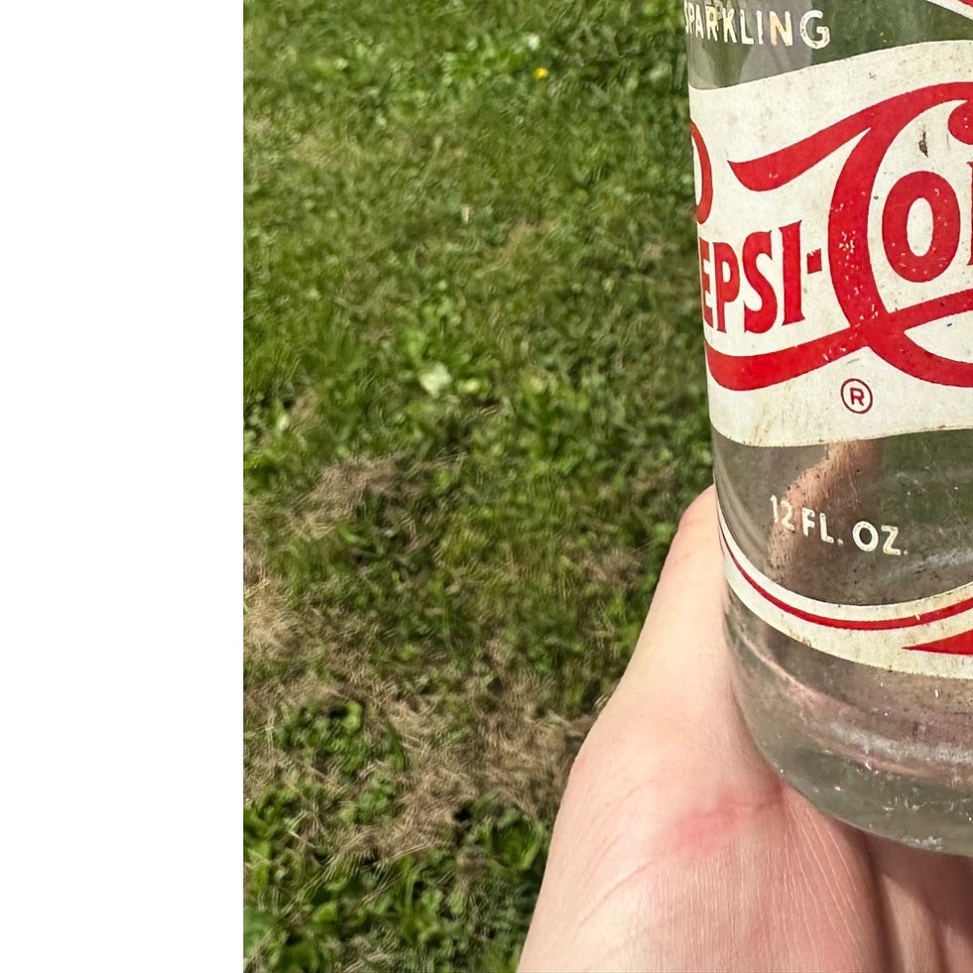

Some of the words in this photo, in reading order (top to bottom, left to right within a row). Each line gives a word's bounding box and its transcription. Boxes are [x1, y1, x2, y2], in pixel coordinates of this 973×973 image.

[769, 494, 796, 531] 12
[801, 506, 845, 546] FL.
[851, 520, 910, 556] OZ.
